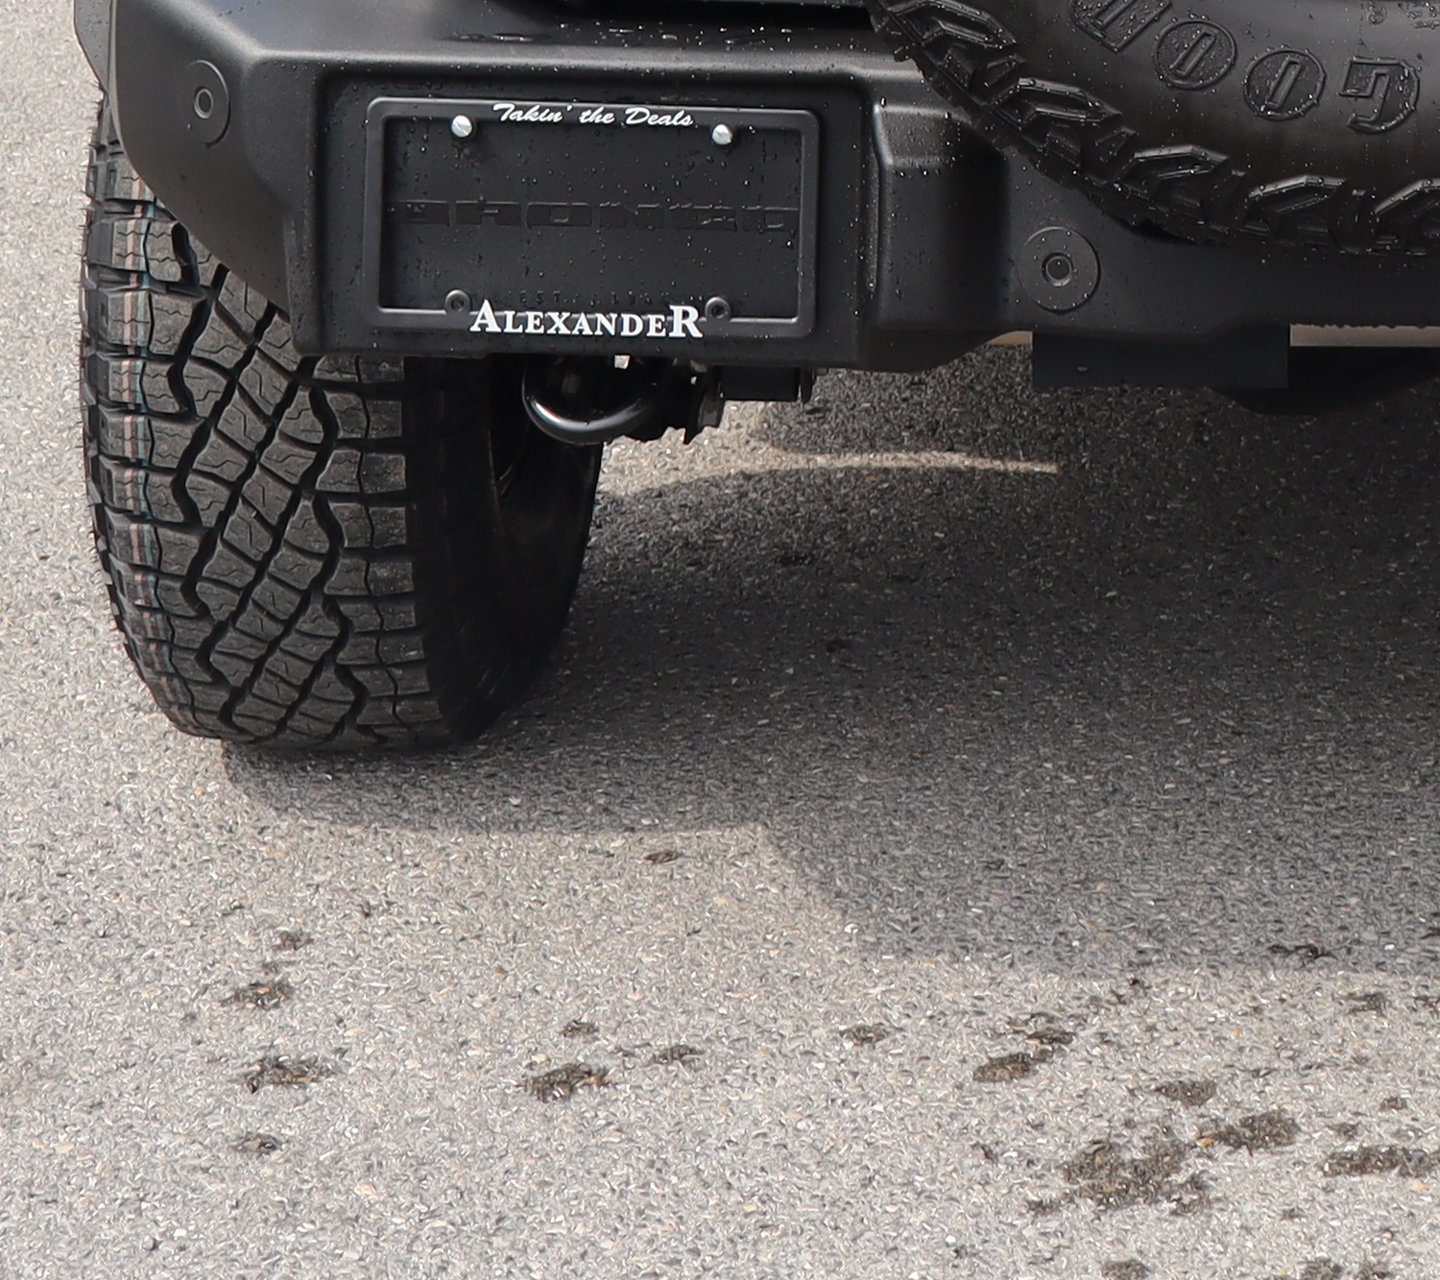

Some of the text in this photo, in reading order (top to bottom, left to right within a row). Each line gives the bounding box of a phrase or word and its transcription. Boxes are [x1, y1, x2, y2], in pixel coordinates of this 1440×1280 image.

[492, 102, 694, 127] Takin' the Deals
[388, 198, 799, 233] BRONCO
[469, 298, 704, 339] ALEXANDER
